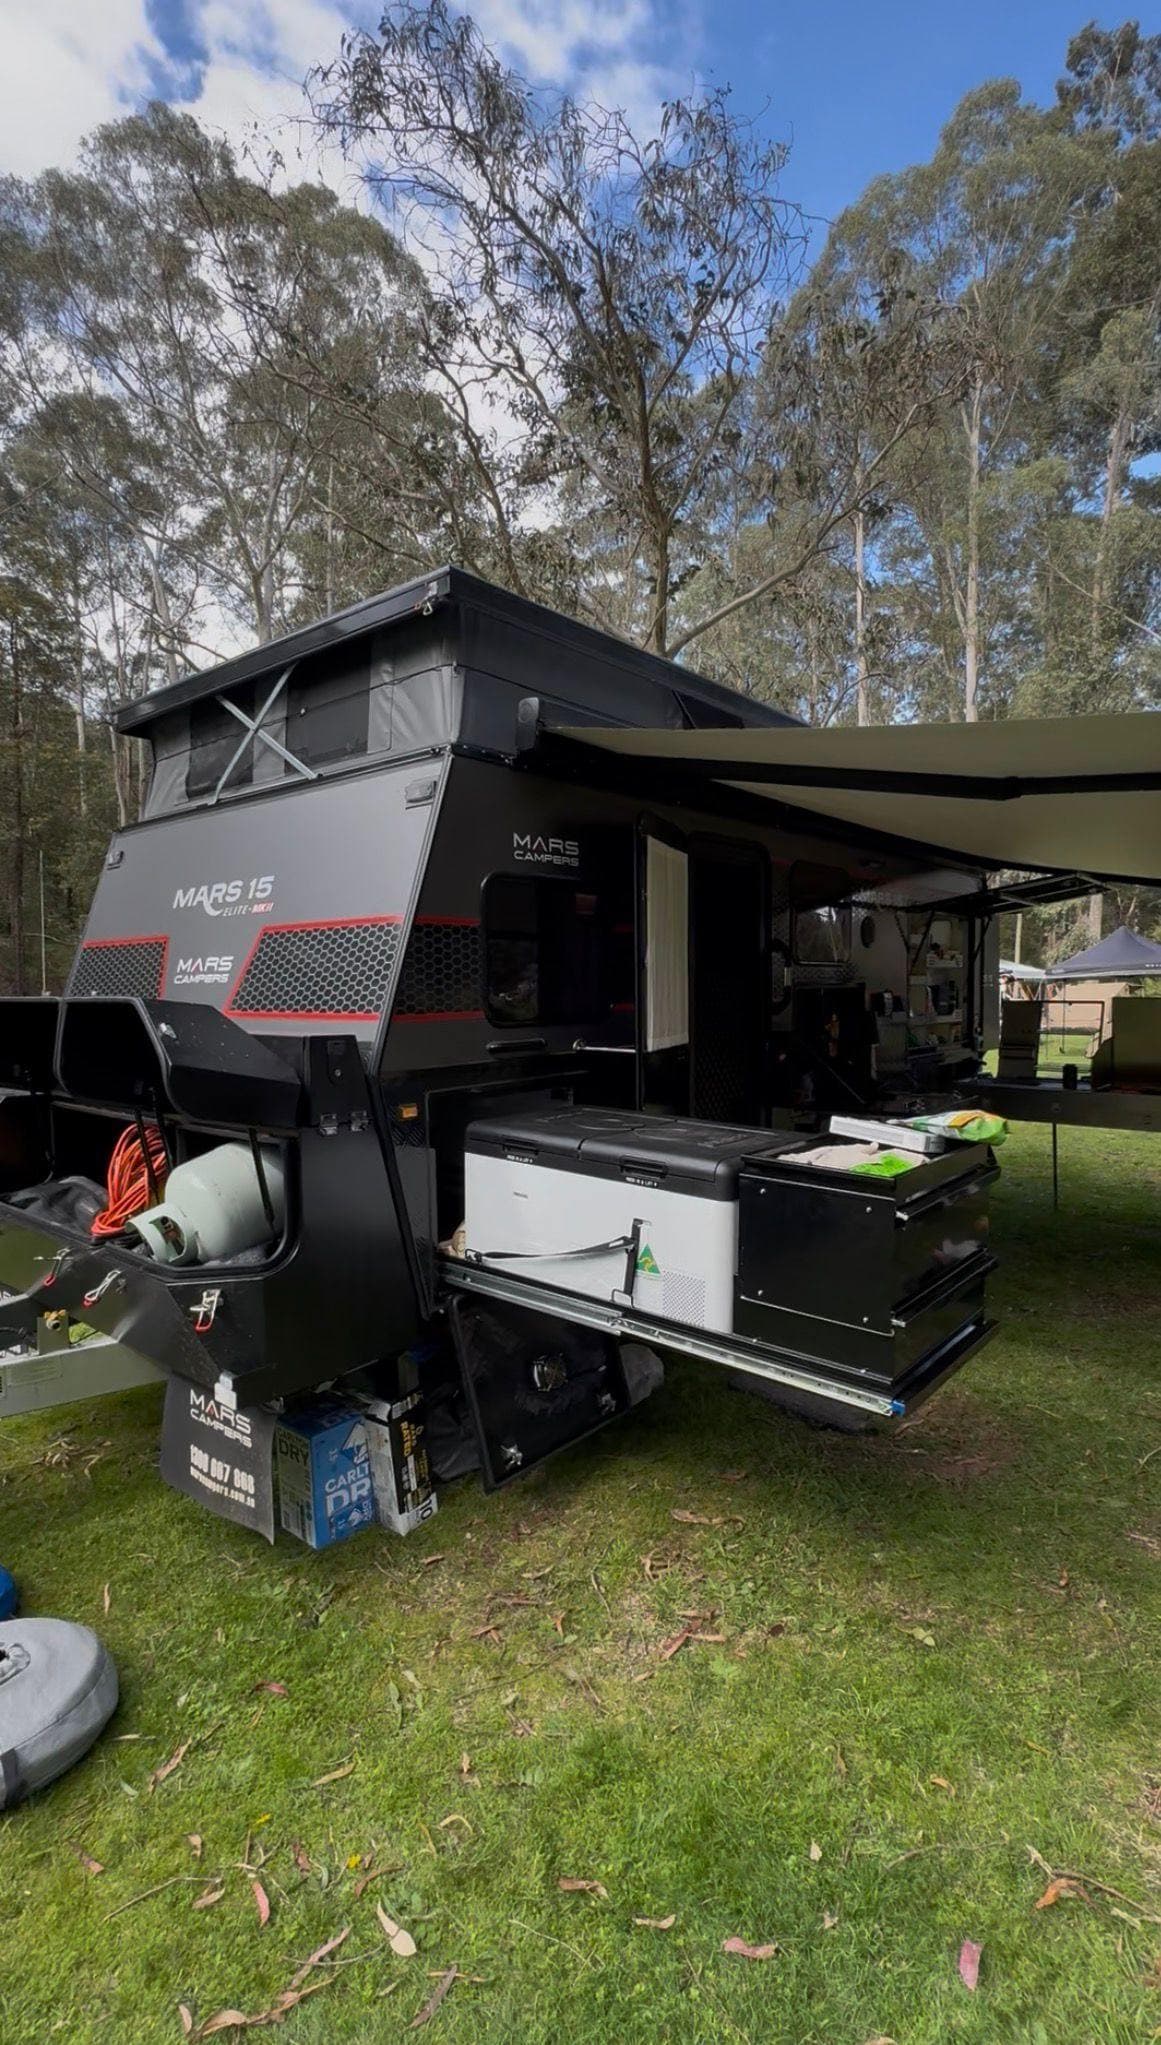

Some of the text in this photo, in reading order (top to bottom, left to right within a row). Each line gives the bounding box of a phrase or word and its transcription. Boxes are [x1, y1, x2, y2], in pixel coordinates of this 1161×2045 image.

[513, 832, 579, 856] MARS
[513, 850, 579, 867] CAMPERS
[172, 875, 275, 915] MARS 15
[174, 973, 230, 984] CAMPERS
[177, 955, 235, 973] MARS
[190, 1388, 251, 1434] MARS
[190, 1408, 252, 1448] CAMPERS
[279, 1438, 309, 1467] DRY
[324, 1460, 370, 1493] CARLT
[326, 1477, 371, 1518] DR
